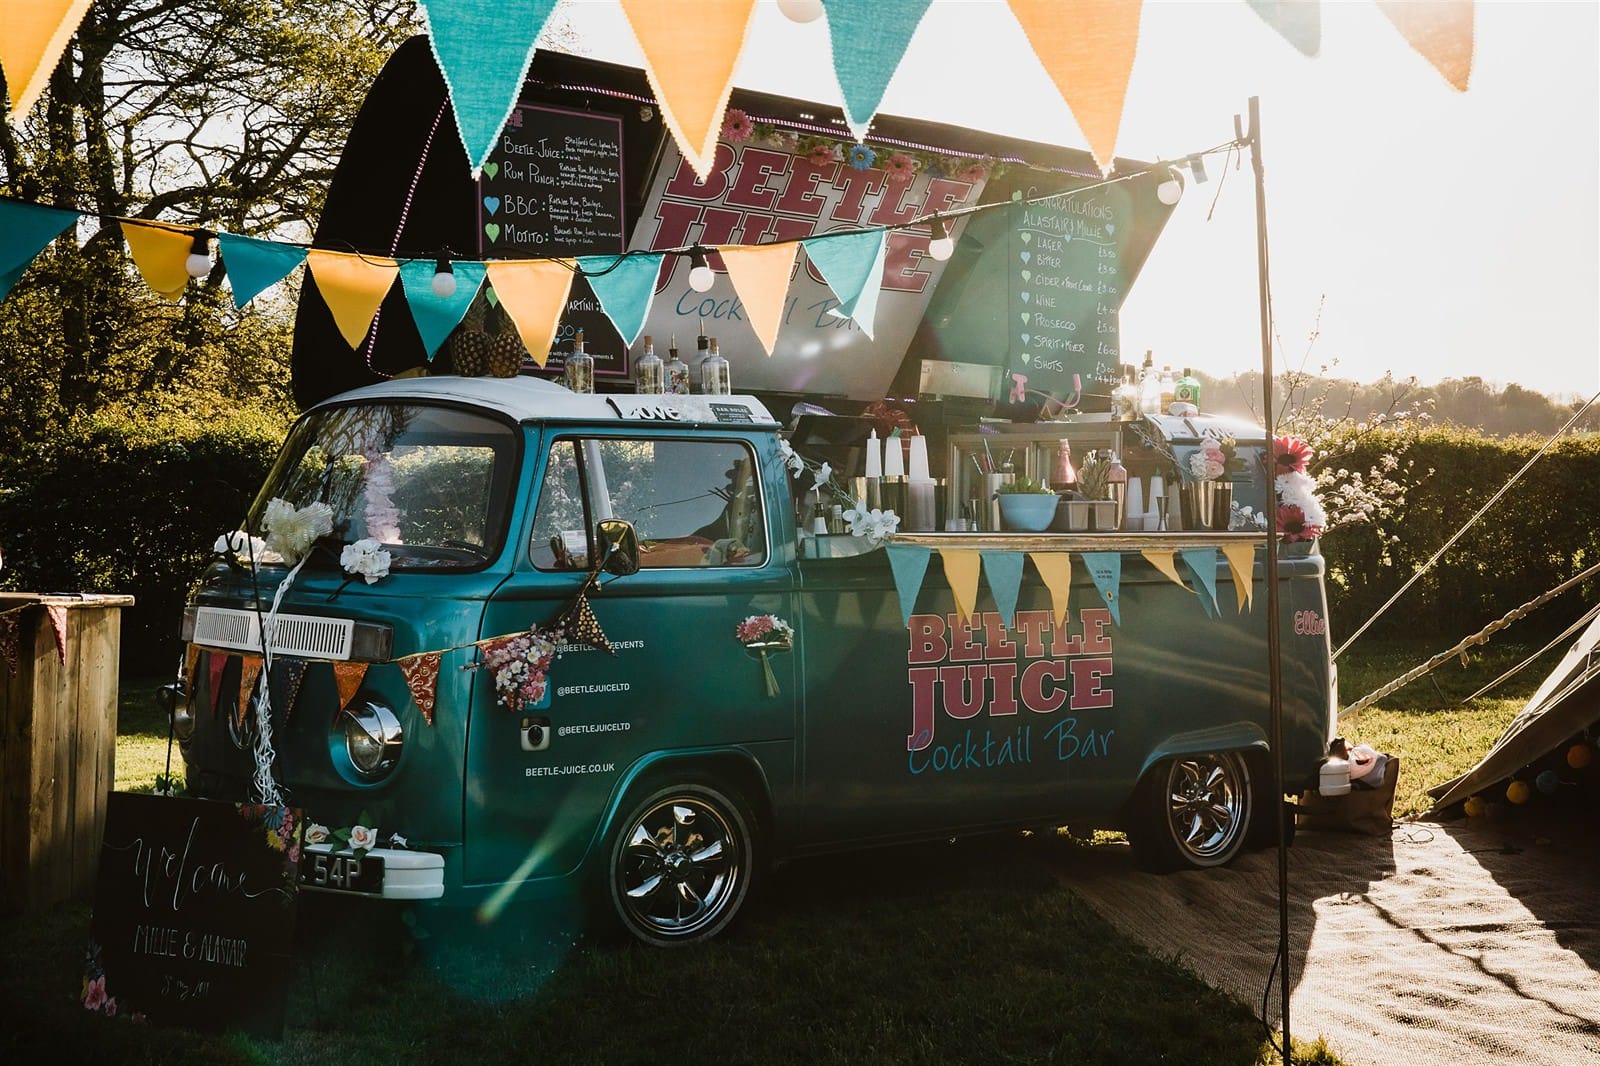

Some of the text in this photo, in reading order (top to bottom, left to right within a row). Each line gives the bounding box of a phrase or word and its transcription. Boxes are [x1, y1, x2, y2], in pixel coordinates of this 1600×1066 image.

[504, 160, 523, 181] RUM
[663, 142, 974, 234] BEETLE
[1027, 186, 1113, 220] CONGRATULATIONS
[1023, 210, 1070, 234] ALASTAIR
[1076, 219, 1103, 238] MILLIE
[653, 200, 934, 294] JUE
[1037, 236, 1064, 253] LAGER
[1036, 254, 1061, 268] BITTER
[1035, 273, 1060, 288] CIDER
[676, 288, 865, 331] Cockl Ba
[1035, 294, 1056, 308] WINE
[1034, 312, 1076, 331] PROSECCO
[1034, 335, 1061, 350] SPIRIT
[1034, 356, 1064, 373] SHOTS
[1294, 610, 1325, 636] Ellie
[907, 608, 1113, 664] BEETLE
[557, 682, 630, 697] @BEETLEJUICELTD
[907, 657, 1114, 751] JUICE
[558, 722, 631, 737] @BEETLEJUICELTD
[908, 717, 1115, 775] Cocktail Bar
[525, 763, 615, 777] BEETLE-JUICE.CO.UK
[314, 855, 362, 888] 54P
[133, 924, 249, 968] MILLIE & ALASTAIR
